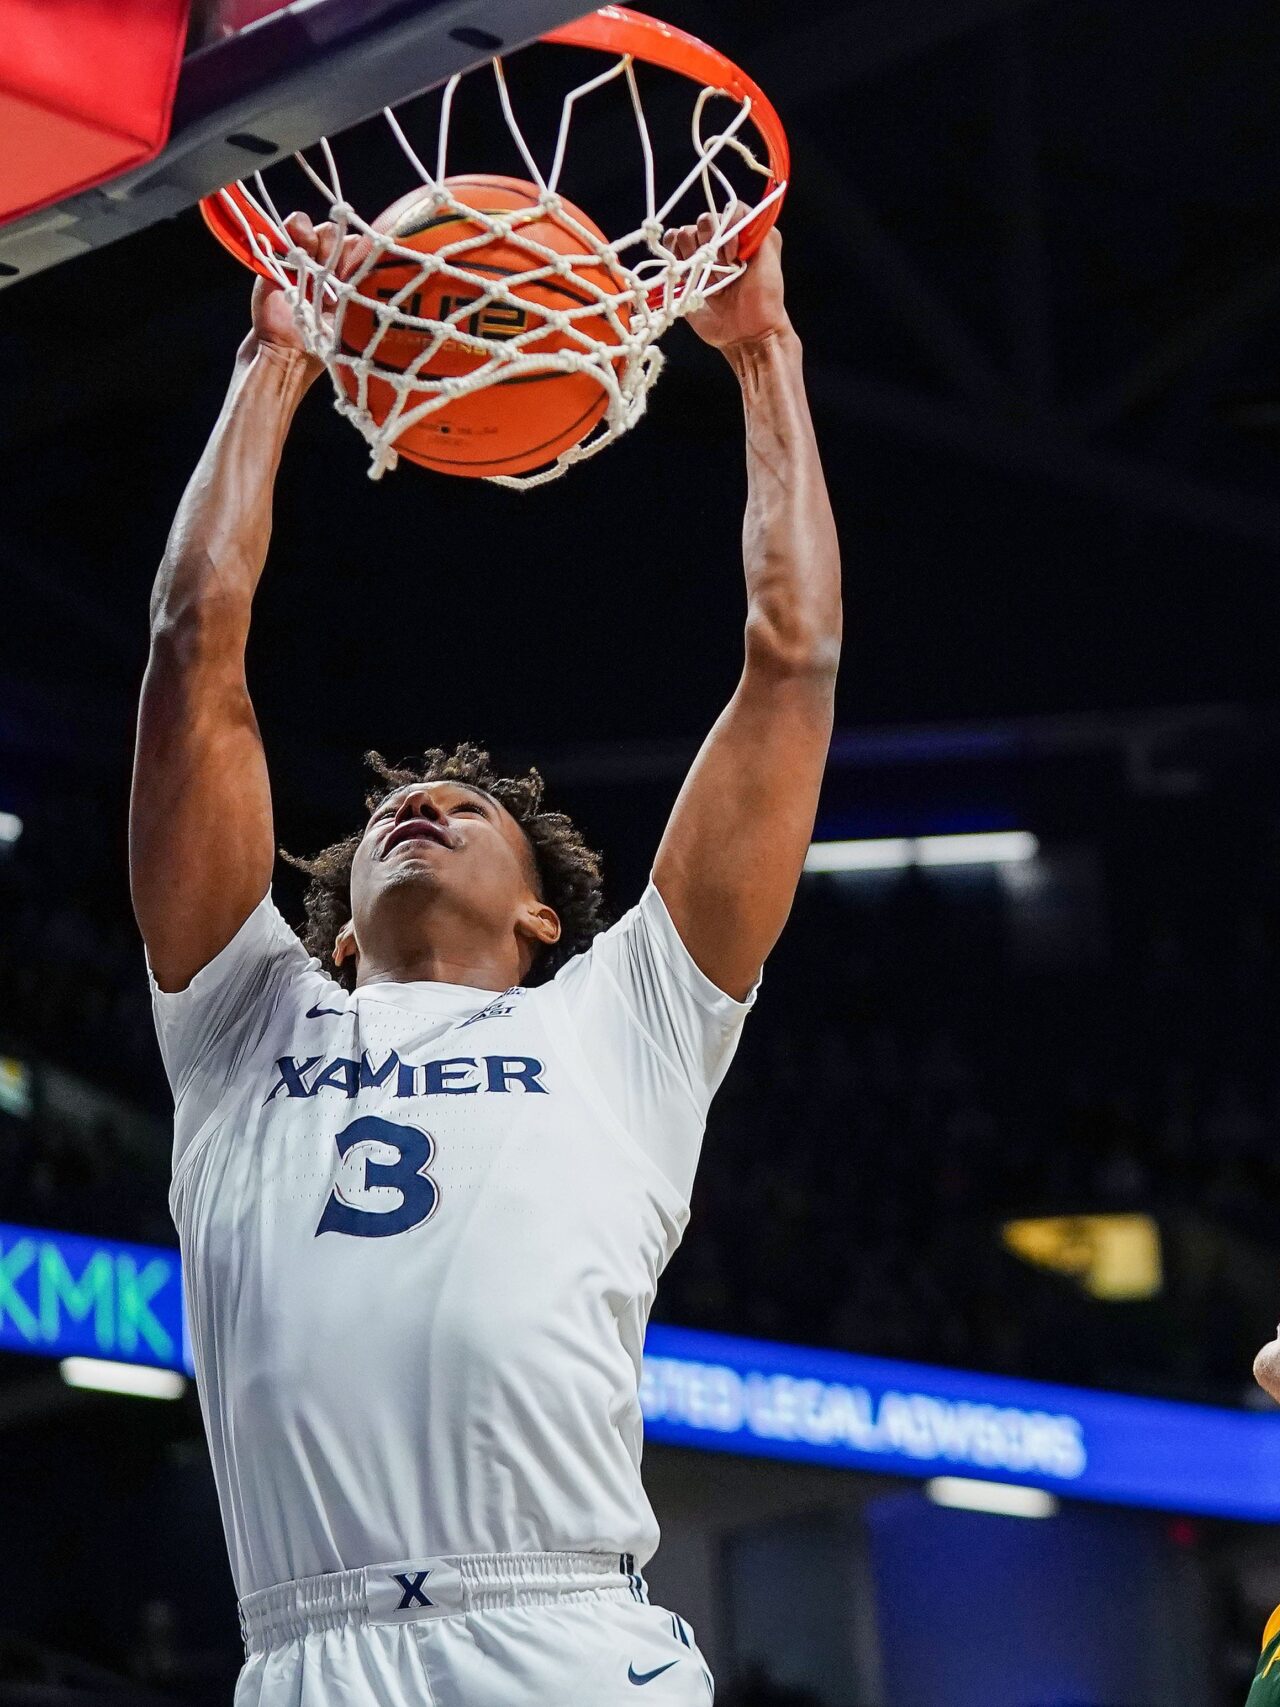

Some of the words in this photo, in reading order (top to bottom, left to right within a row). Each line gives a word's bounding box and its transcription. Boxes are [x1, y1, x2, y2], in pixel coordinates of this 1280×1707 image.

[261, 1048, 550, 1107] XAVIER
[314, 1114, 440, 1238] 3
[393, 1570, 436, 1611] X
